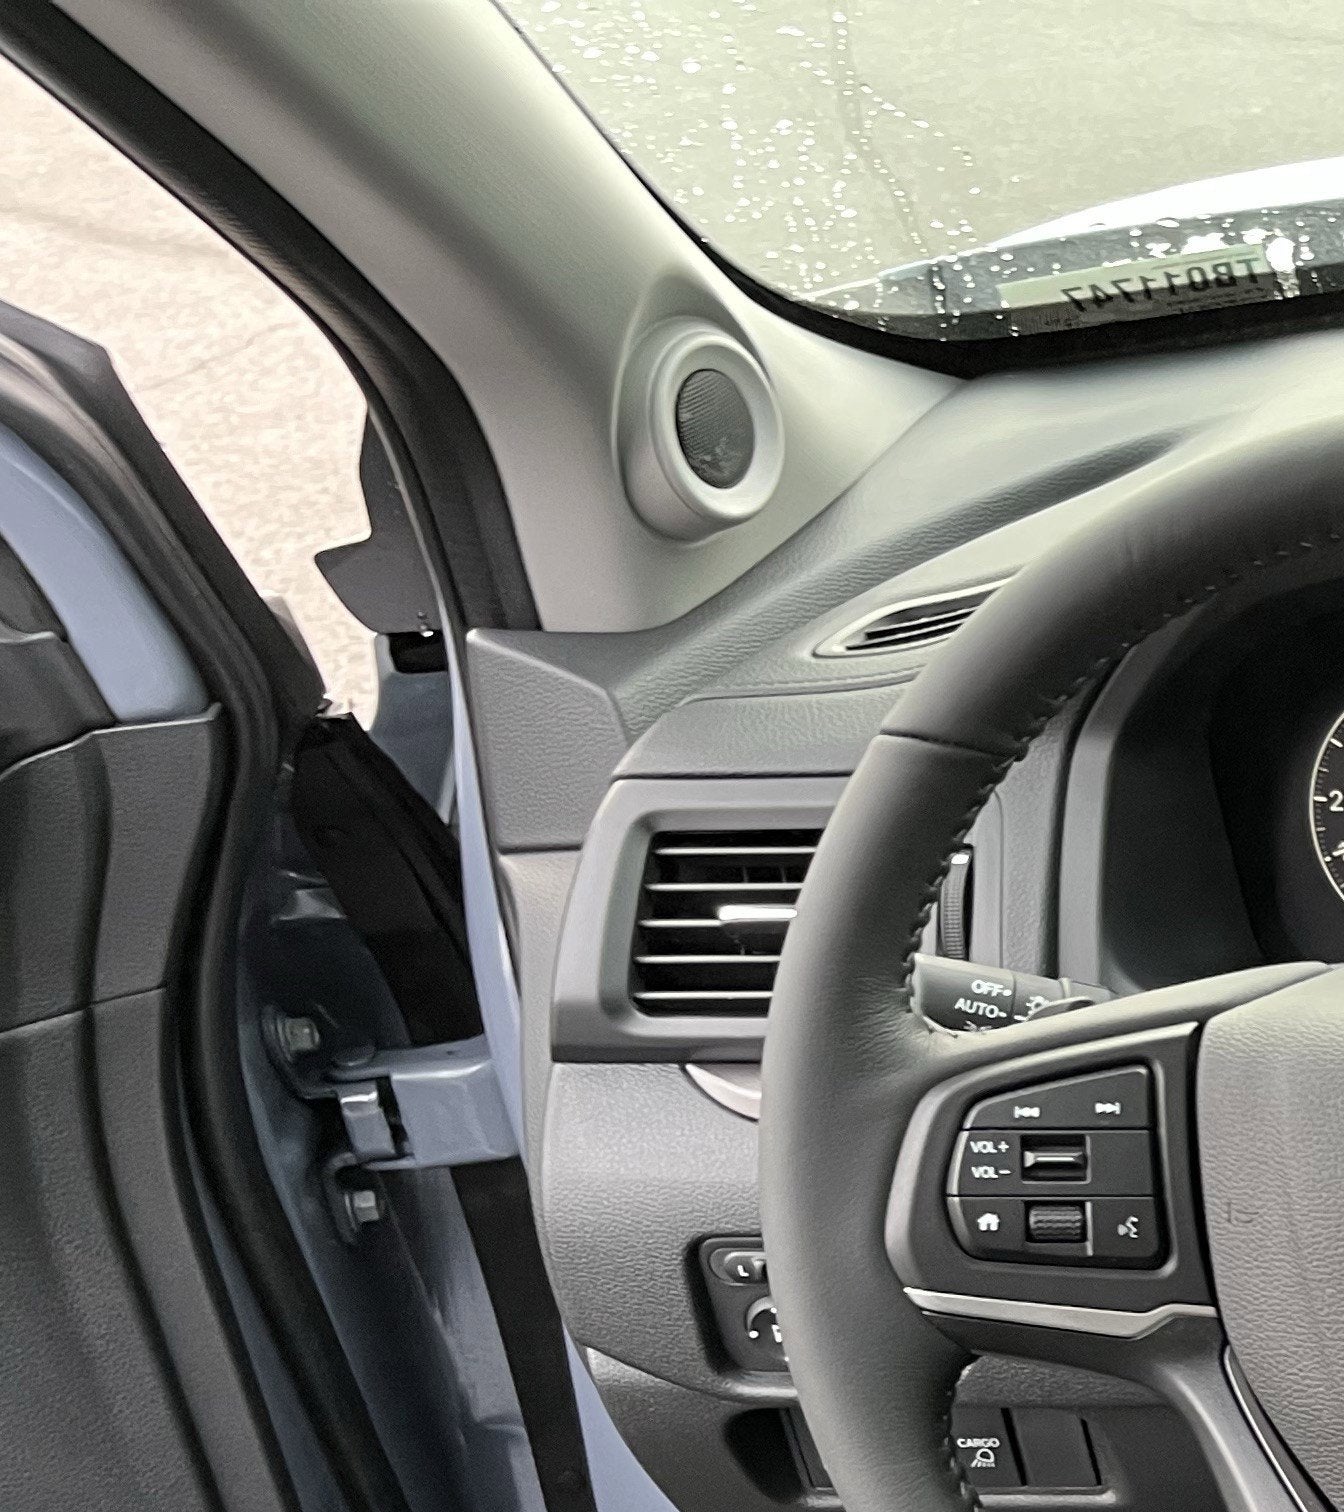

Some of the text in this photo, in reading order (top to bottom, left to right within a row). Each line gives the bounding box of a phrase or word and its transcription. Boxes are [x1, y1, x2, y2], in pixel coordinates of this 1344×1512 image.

[1329, 790, 1344, 812] 2
[971, 980, 1004, 997] OFF
[955, 998, 999, 1018] AUTO
[956, 1437, 1000, 1449] CARGO
